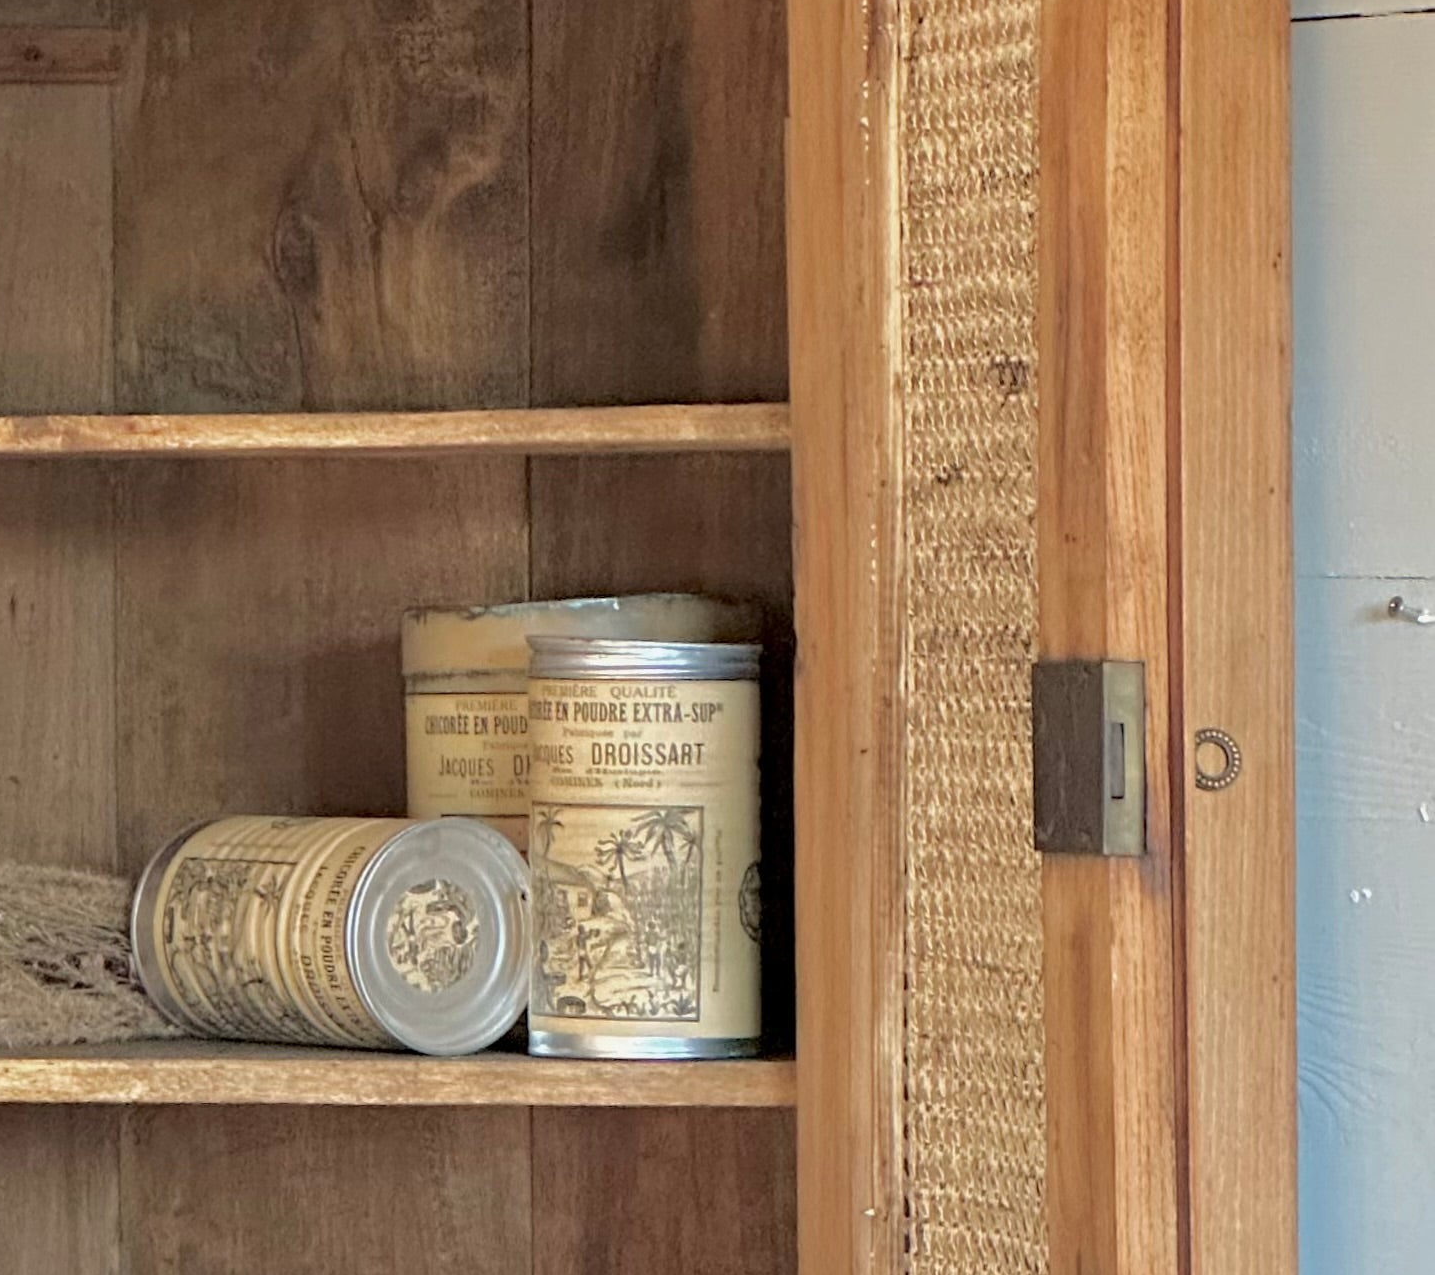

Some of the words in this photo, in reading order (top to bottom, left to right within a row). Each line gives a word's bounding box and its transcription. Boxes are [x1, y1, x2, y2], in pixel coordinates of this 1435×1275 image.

[610, 684, 677, 701] QUALITÉ
[555, 700, 570, 722] EN
[573, 700, 627, 723] POUDRE
[473, 715, 489, 736] EN
[439, 753, 495, 779] JACQUES
[591, 742, 705, 767] DROISSART
[321, 910, 334, 928] EN
[321, 934, 342, 991] POUDRE
